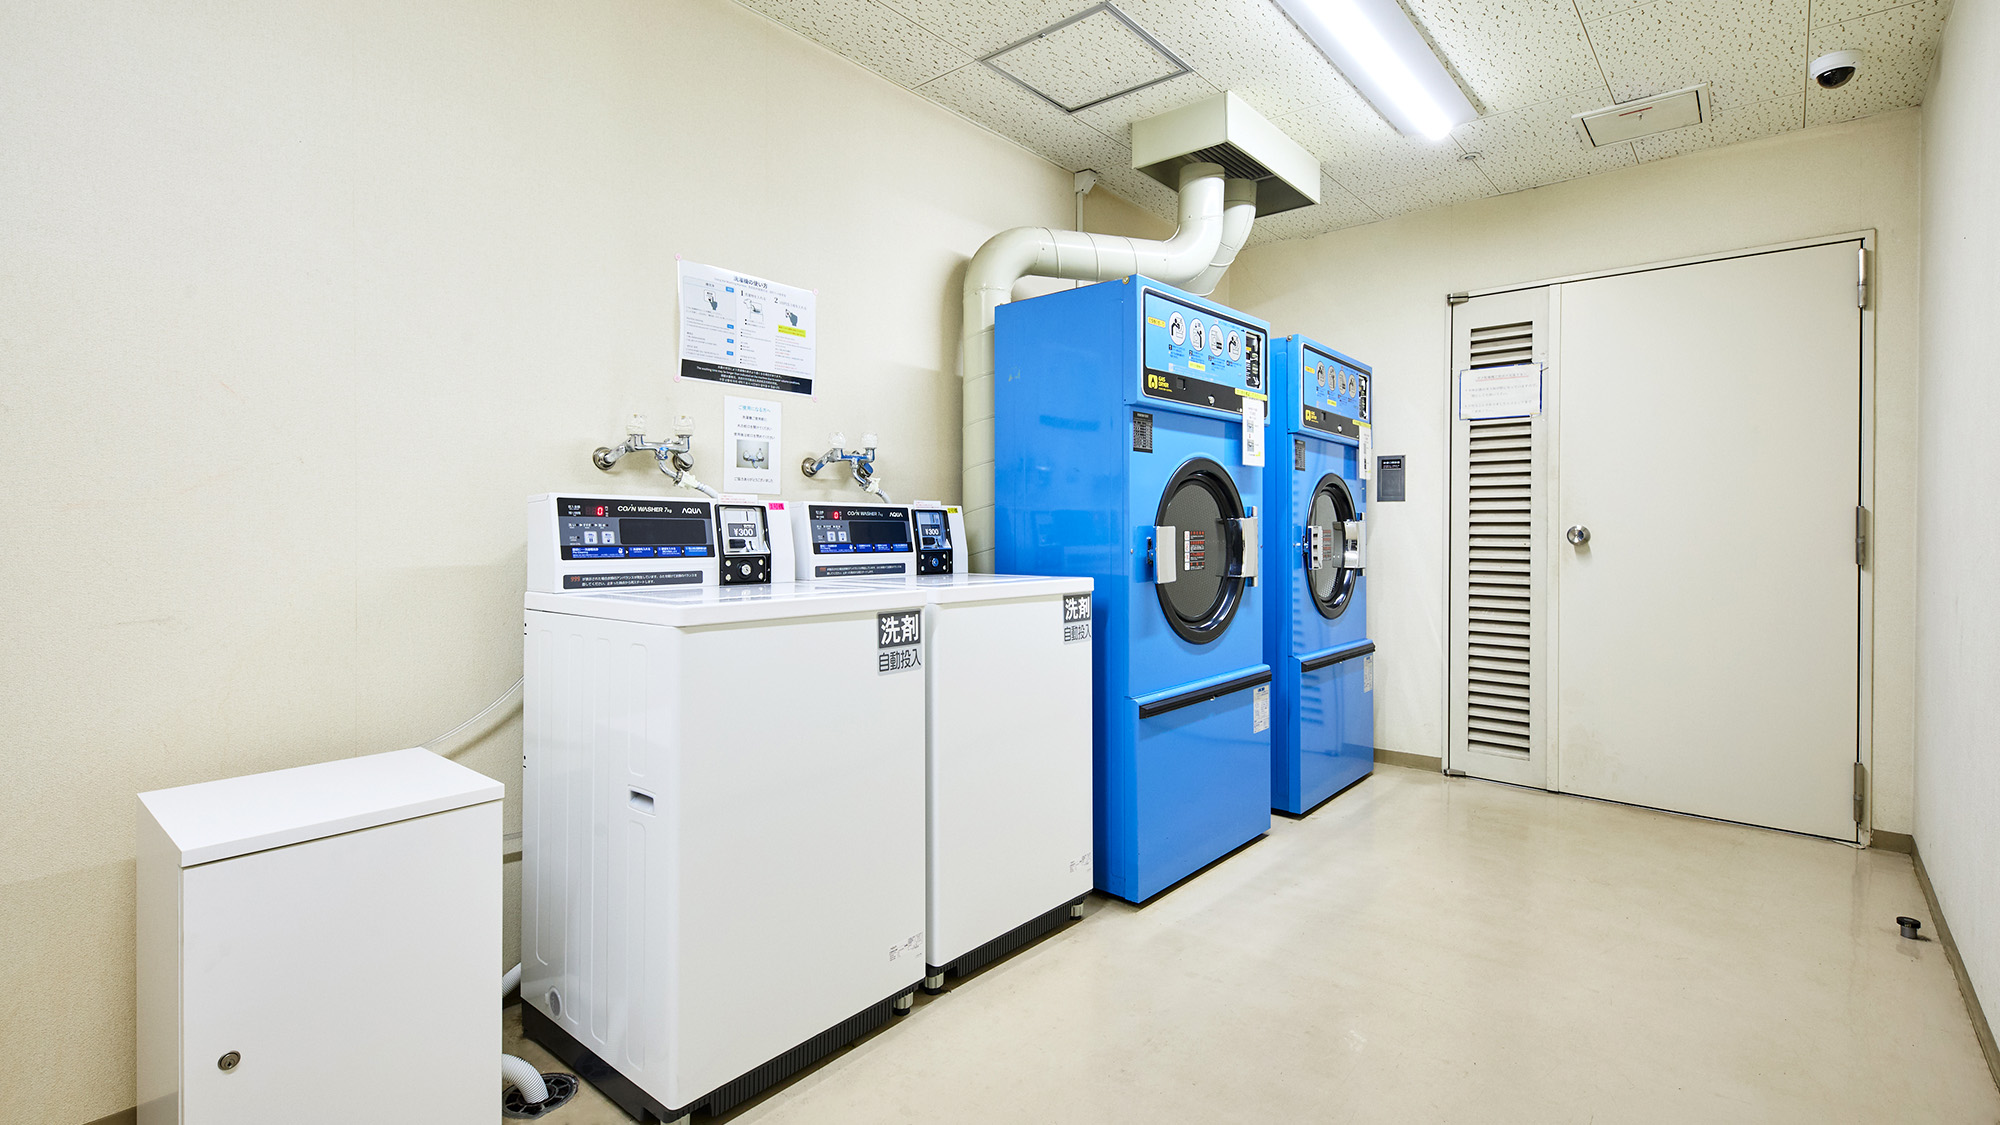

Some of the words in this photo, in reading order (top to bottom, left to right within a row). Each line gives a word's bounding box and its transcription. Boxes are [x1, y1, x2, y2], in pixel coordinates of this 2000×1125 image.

[597, 506, 604, 516] 0
[617, 504, 636, 512] COIN
[834, 511, 839, 520] 0
[734, 528, 753, 536] ¥300
[1065, 597, 1090, 620] 洗剤
[881, 613, 920, 645] 洗剤
[1064, 624, 1091, 642] 自動投入
[879, 649, 921, 672] 自動投入
